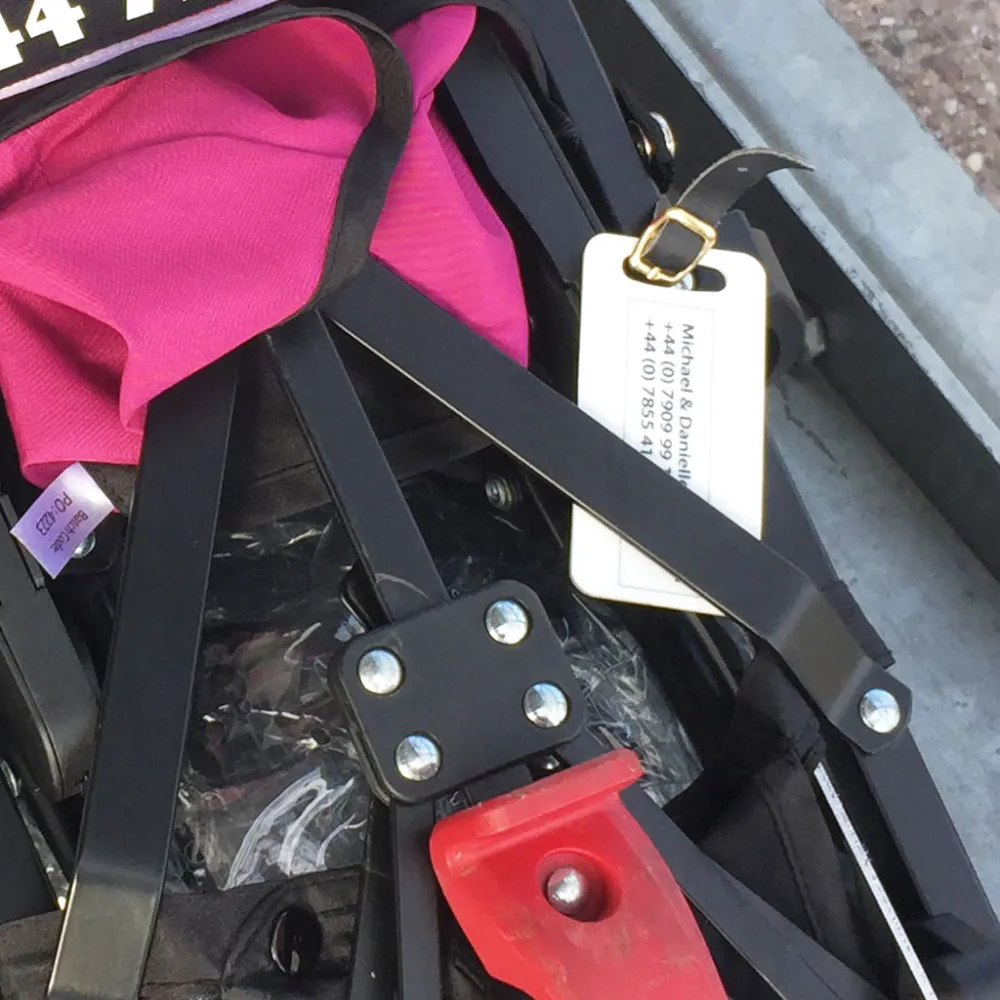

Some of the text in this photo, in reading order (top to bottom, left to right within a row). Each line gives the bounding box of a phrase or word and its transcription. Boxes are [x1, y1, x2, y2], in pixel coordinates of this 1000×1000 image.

[663, 322, 675, 355] +44
[660, 360, 675, 384] (0)
[680, 323, 695, 393] Michael
[640, 318, 656, 455] +44 (0) 7855 41
[660, 389, 674, 433] 7909
[679, 397, 693, 411] &
[660, 438, 672, 461] 99
